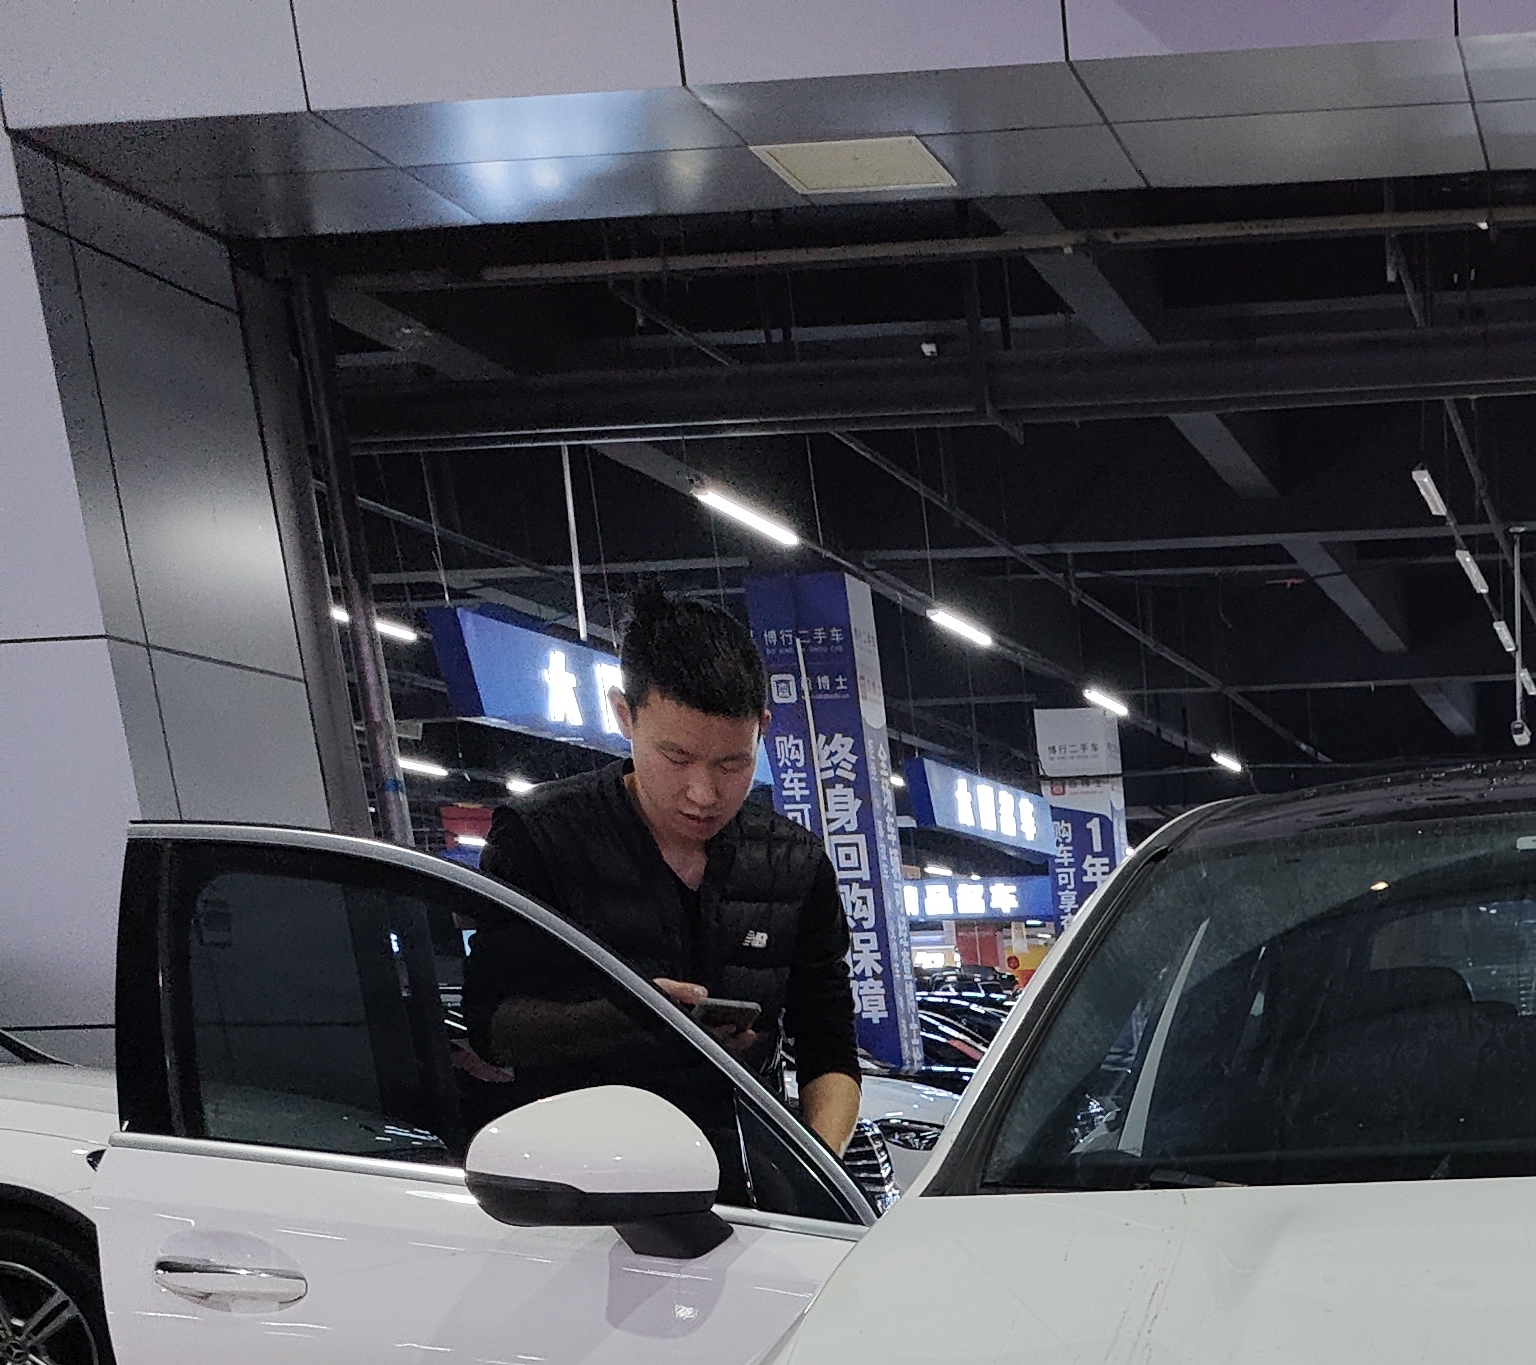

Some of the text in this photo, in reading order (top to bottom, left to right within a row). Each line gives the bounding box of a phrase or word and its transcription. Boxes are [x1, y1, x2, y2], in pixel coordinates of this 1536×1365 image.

[763, 627, 844, 646] 博行二手车
[816, 733, 889, 1025] 终身回购保障
